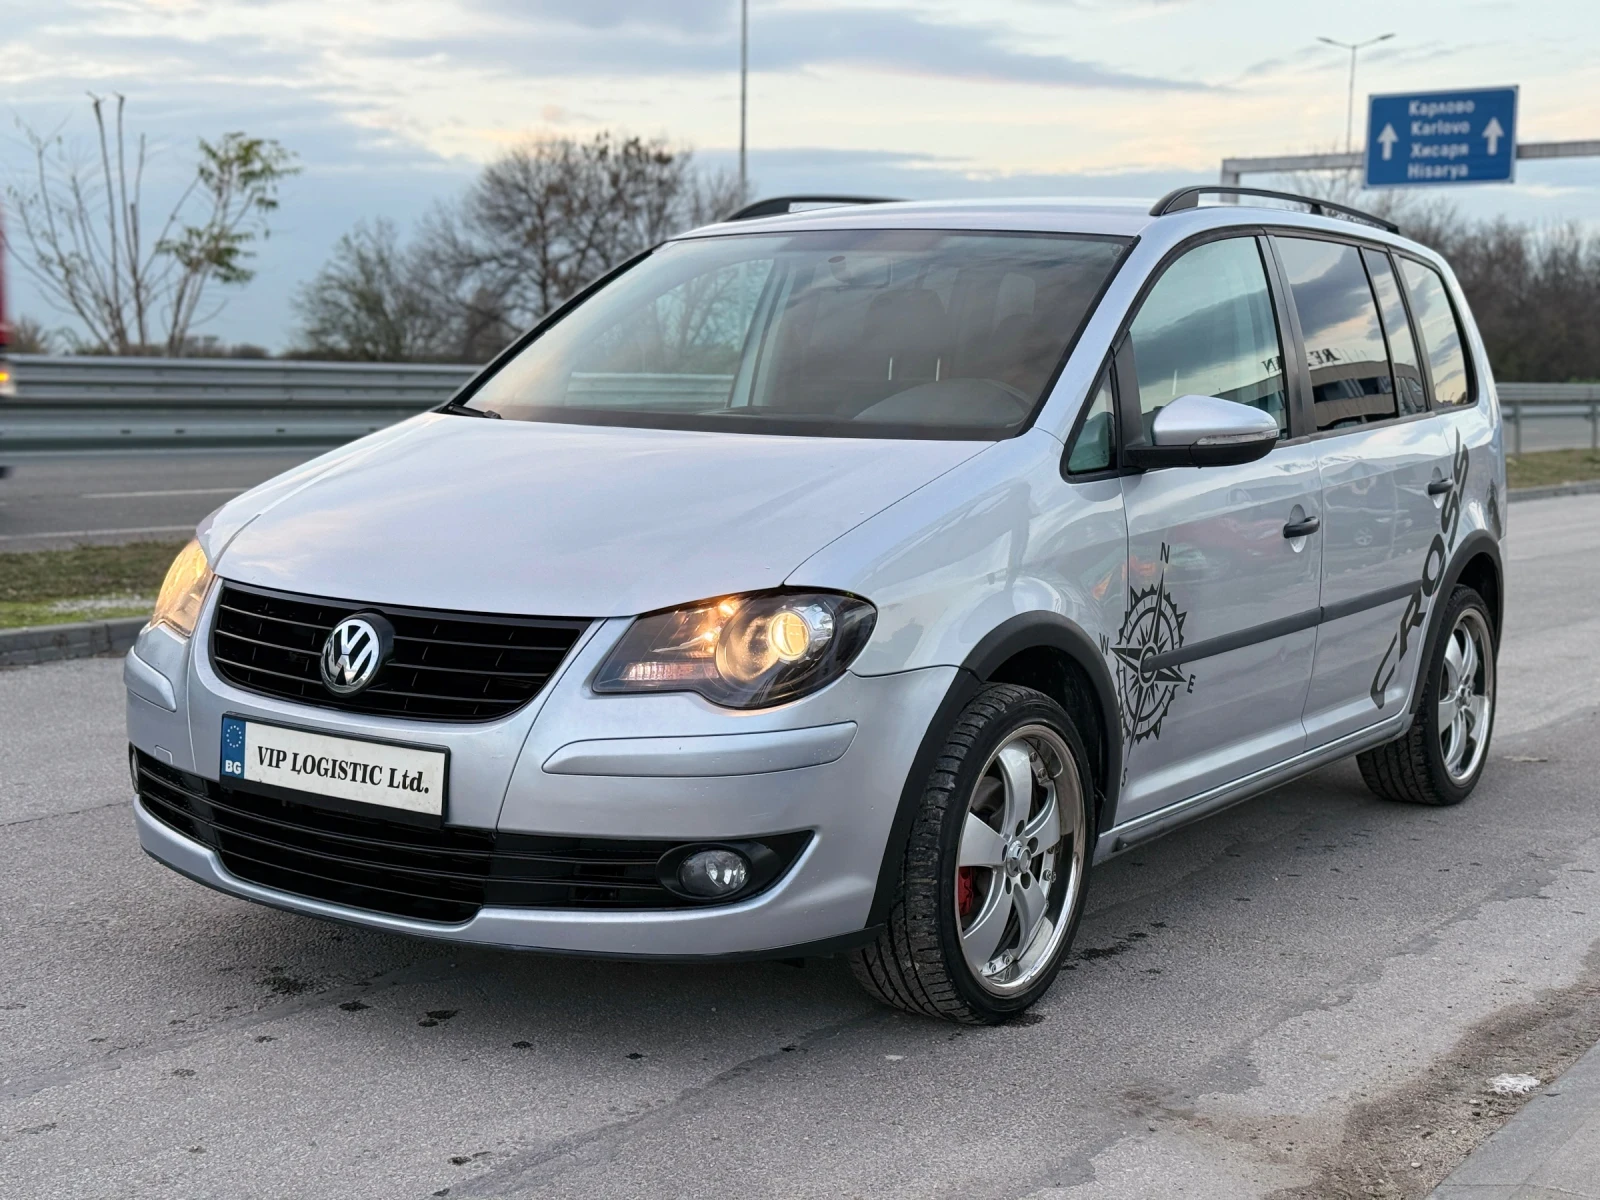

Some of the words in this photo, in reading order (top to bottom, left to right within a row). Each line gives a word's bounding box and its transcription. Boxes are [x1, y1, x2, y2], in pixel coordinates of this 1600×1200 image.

[1409, 100, 1474, 118] Карлово
[1410, 120, 1471, 136] Karlovo
[1407, 162, 1468, 180] Hisarya
[1160, 541, 1170, 564] N
[1370, 426, 1469, 709] CROSS
[1099, 632, 1109, 656] W
[322, 617, 380, 693] VW
[1186, 674, 1196, 694] E
[224, 759, 242, 775] BG
[257, 746, 287, 769] VIP
[290, 752, 383, 786] LOGISTIC
[387, 767, 430, 794] Ltd.
